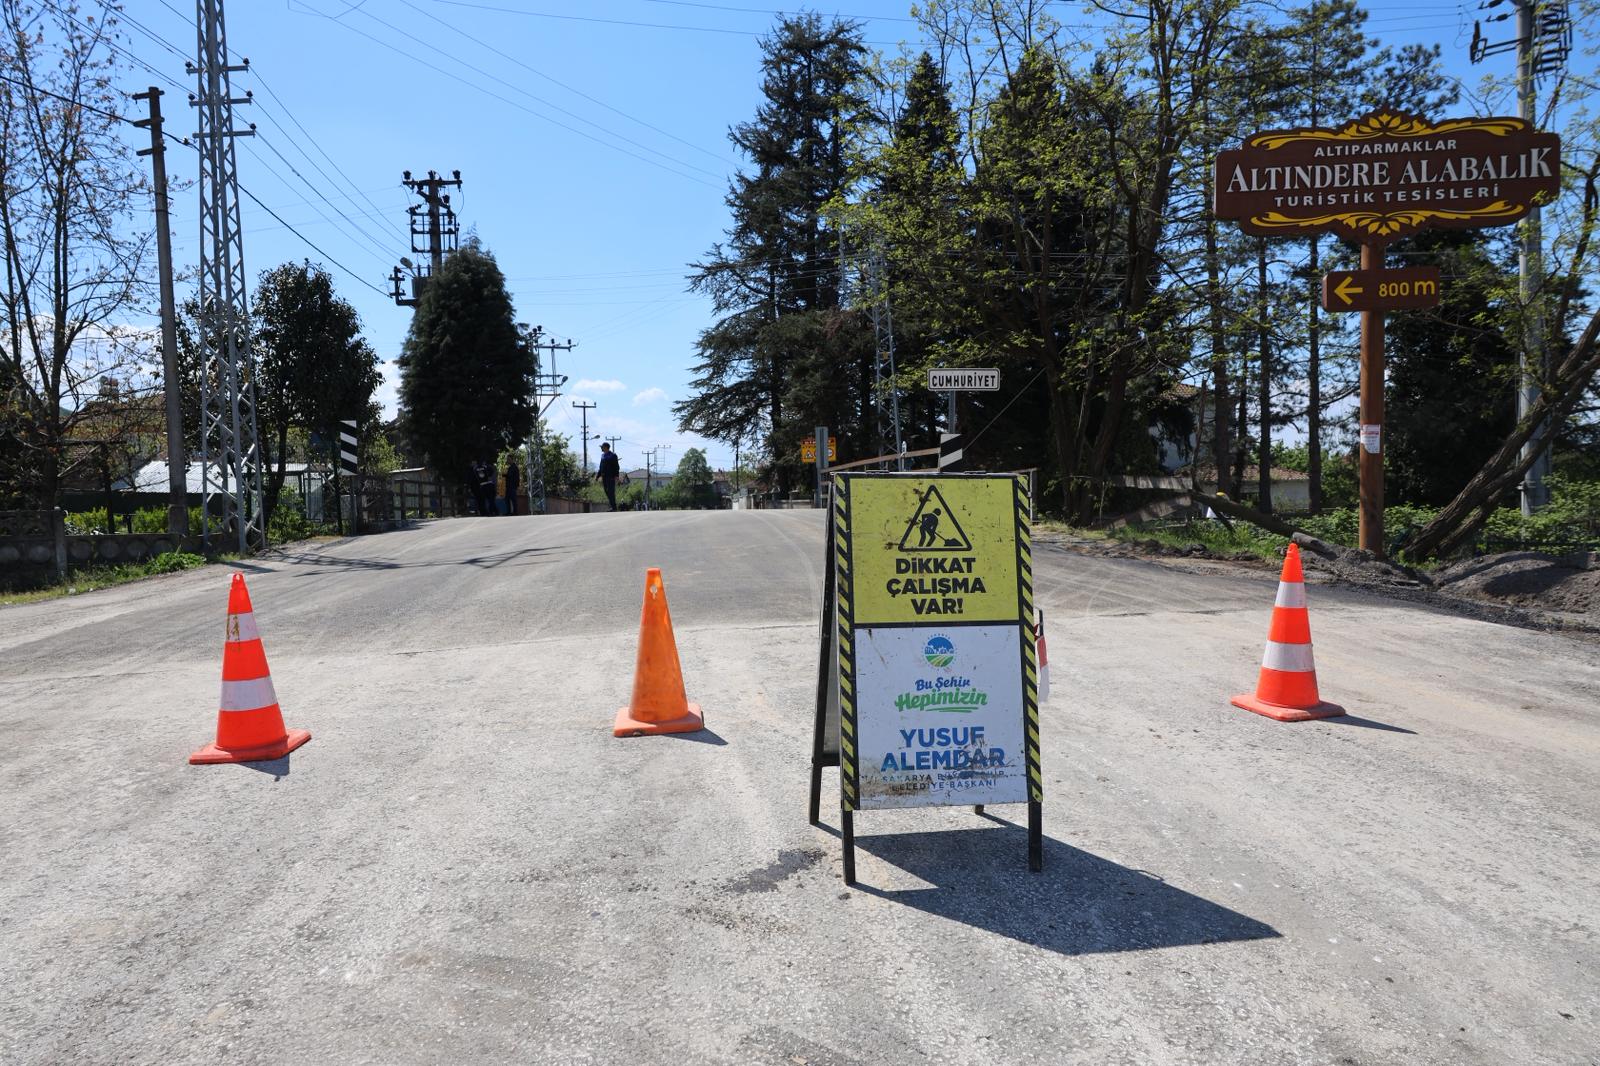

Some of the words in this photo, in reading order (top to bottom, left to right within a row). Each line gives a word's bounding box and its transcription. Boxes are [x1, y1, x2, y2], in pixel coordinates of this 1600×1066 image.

[1314, 139, 1457, 157] ALTIPARMAKLAR
[1226, 161, 1391, 193] ALTINDERE
[1399, 147, 1552, 185] ALABALIK
[1275, 190, 1375, 208] TURİSTİK
[1383, 183, 1499, 203] TESİSLERİ
[1378, 282, 1409, 298] 800
[1414, 279, 1435, 296] m
[931, 371, 996, 387] CUMHURİYET
[886, 577, 986, 598] ÇALIŞMA
[910, 598, 964, 614] VAR!
[915, 679, 933, 692] Bu
[935, 676, 971, 692] Şehir
[894, 687, 988, 712] Hepimizin
[900, 726, 985, 748] YUSUF
[881, 747, 1006, 772] ALEMDAR
